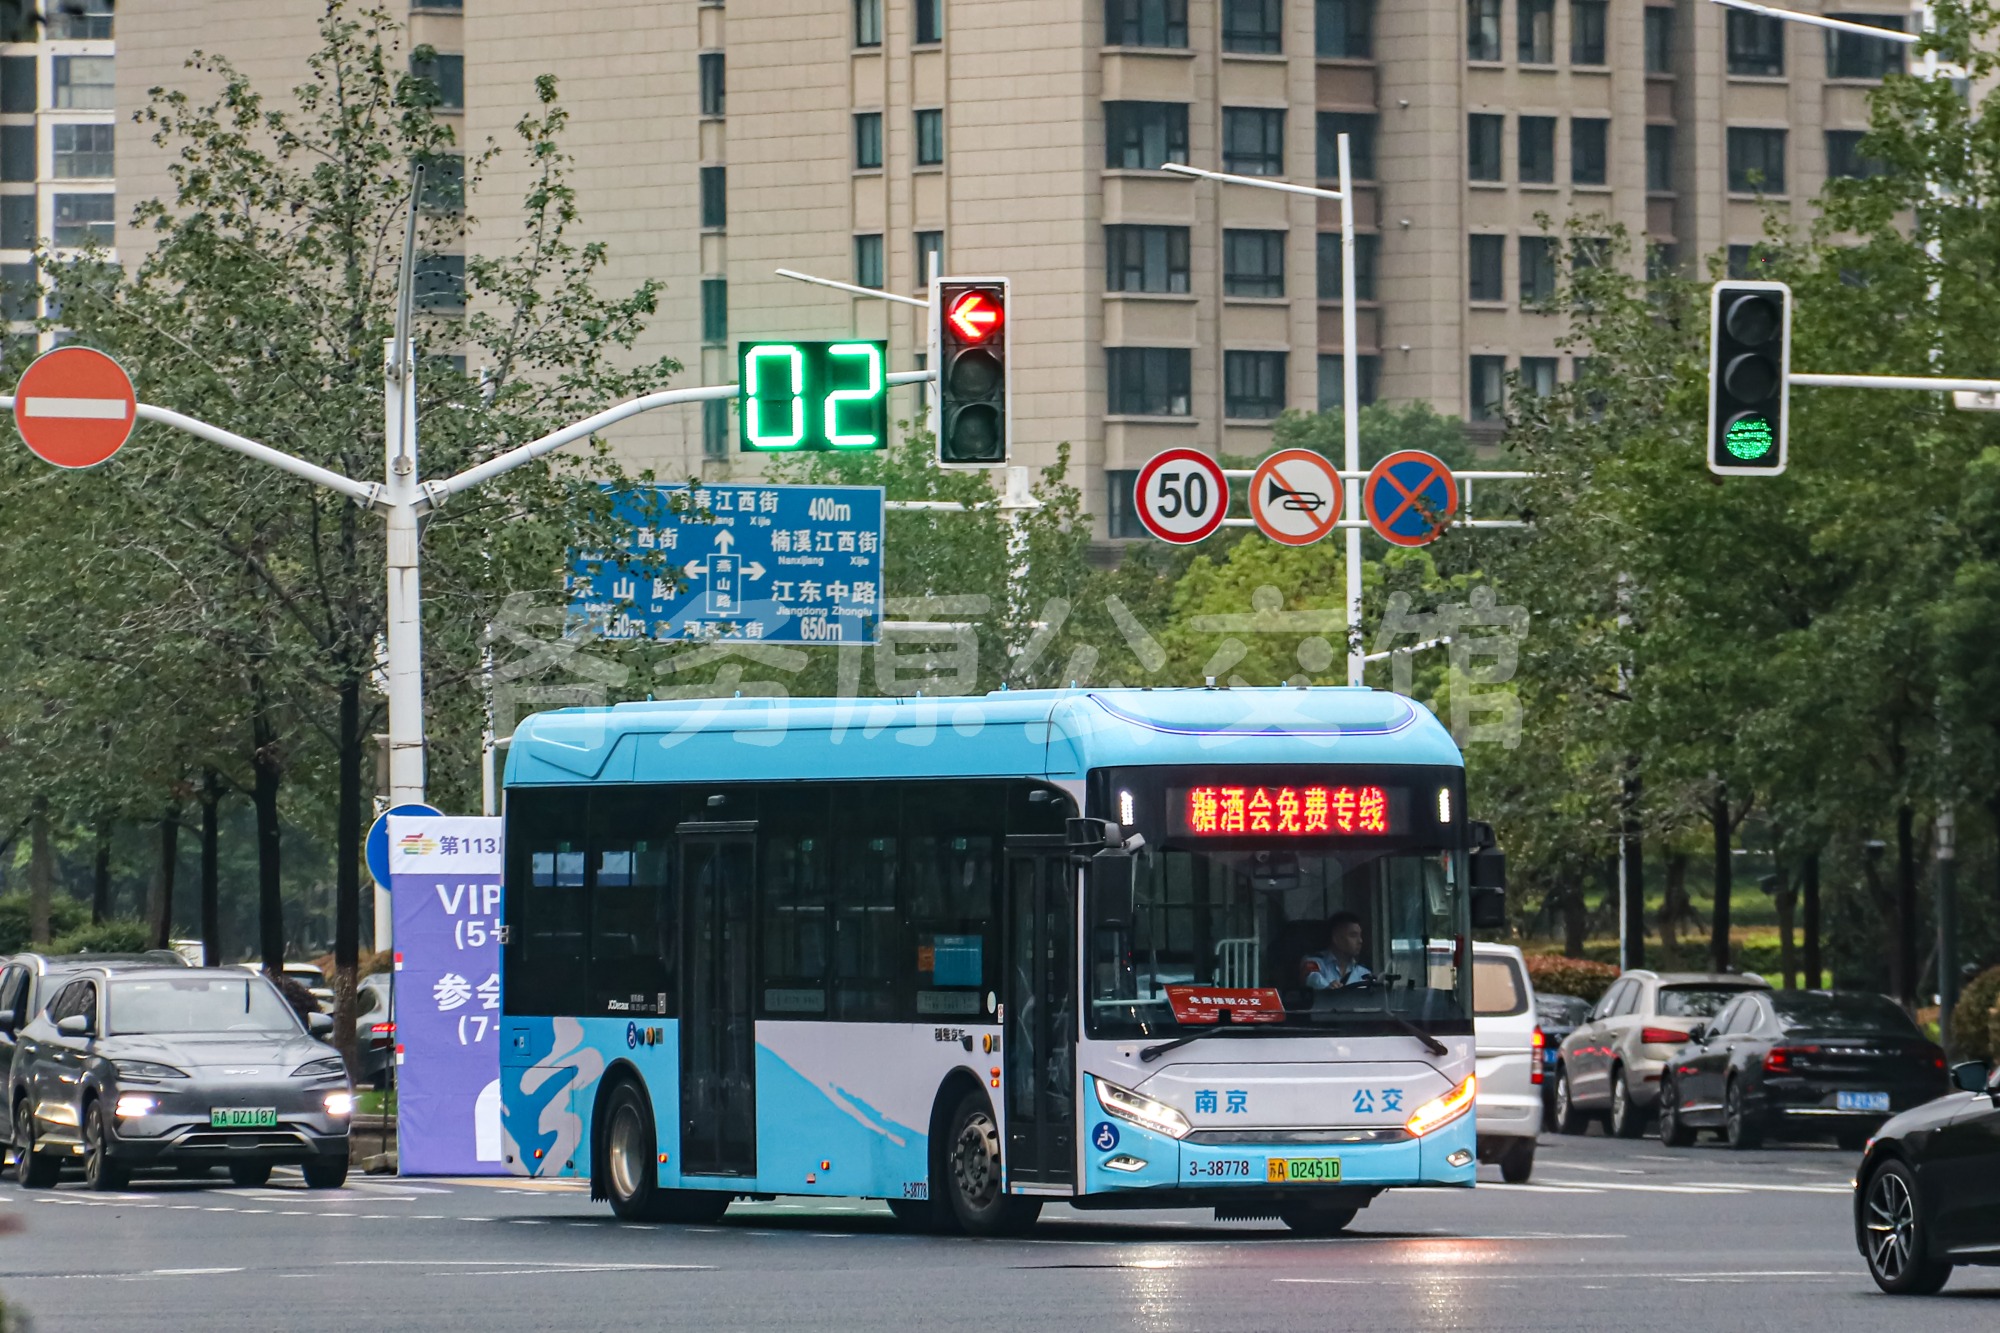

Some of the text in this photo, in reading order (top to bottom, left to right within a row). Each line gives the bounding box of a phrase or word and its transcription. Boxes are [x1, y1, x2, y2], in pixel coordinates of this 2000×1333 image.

[744, 343, 881, 447] 02
[1157, 472, 1208, 519] 50
[808, 497, 851, 521] 400m
[770, 529, 878, 553] 楠溪江西街
[849, 556, 870, 567] Xijie
[715, 559, 732, 608] 燕山路
[770, 580, 877, 605] 江东中路
[650, 603, 663, 613] Lu
[776, 605, 873, 618] Jiangdong Zhonglu
[800, 616, 843, 641] 650m
[1191, 787, 1386, 833] 糖酒会免费专线
[440, 835, 501, 856] 第113
[435, 884, 500, 915] VIP
[458, 1014, 499, 1046] (7
[1194, 1088, 1403, 1114] 南京 公交
[232, 1110, 275, 1124] DZ1187
[1189, 1160, 1249, 1176] 3-38778
[1291, 1161, 1340, 1178] 02451D
